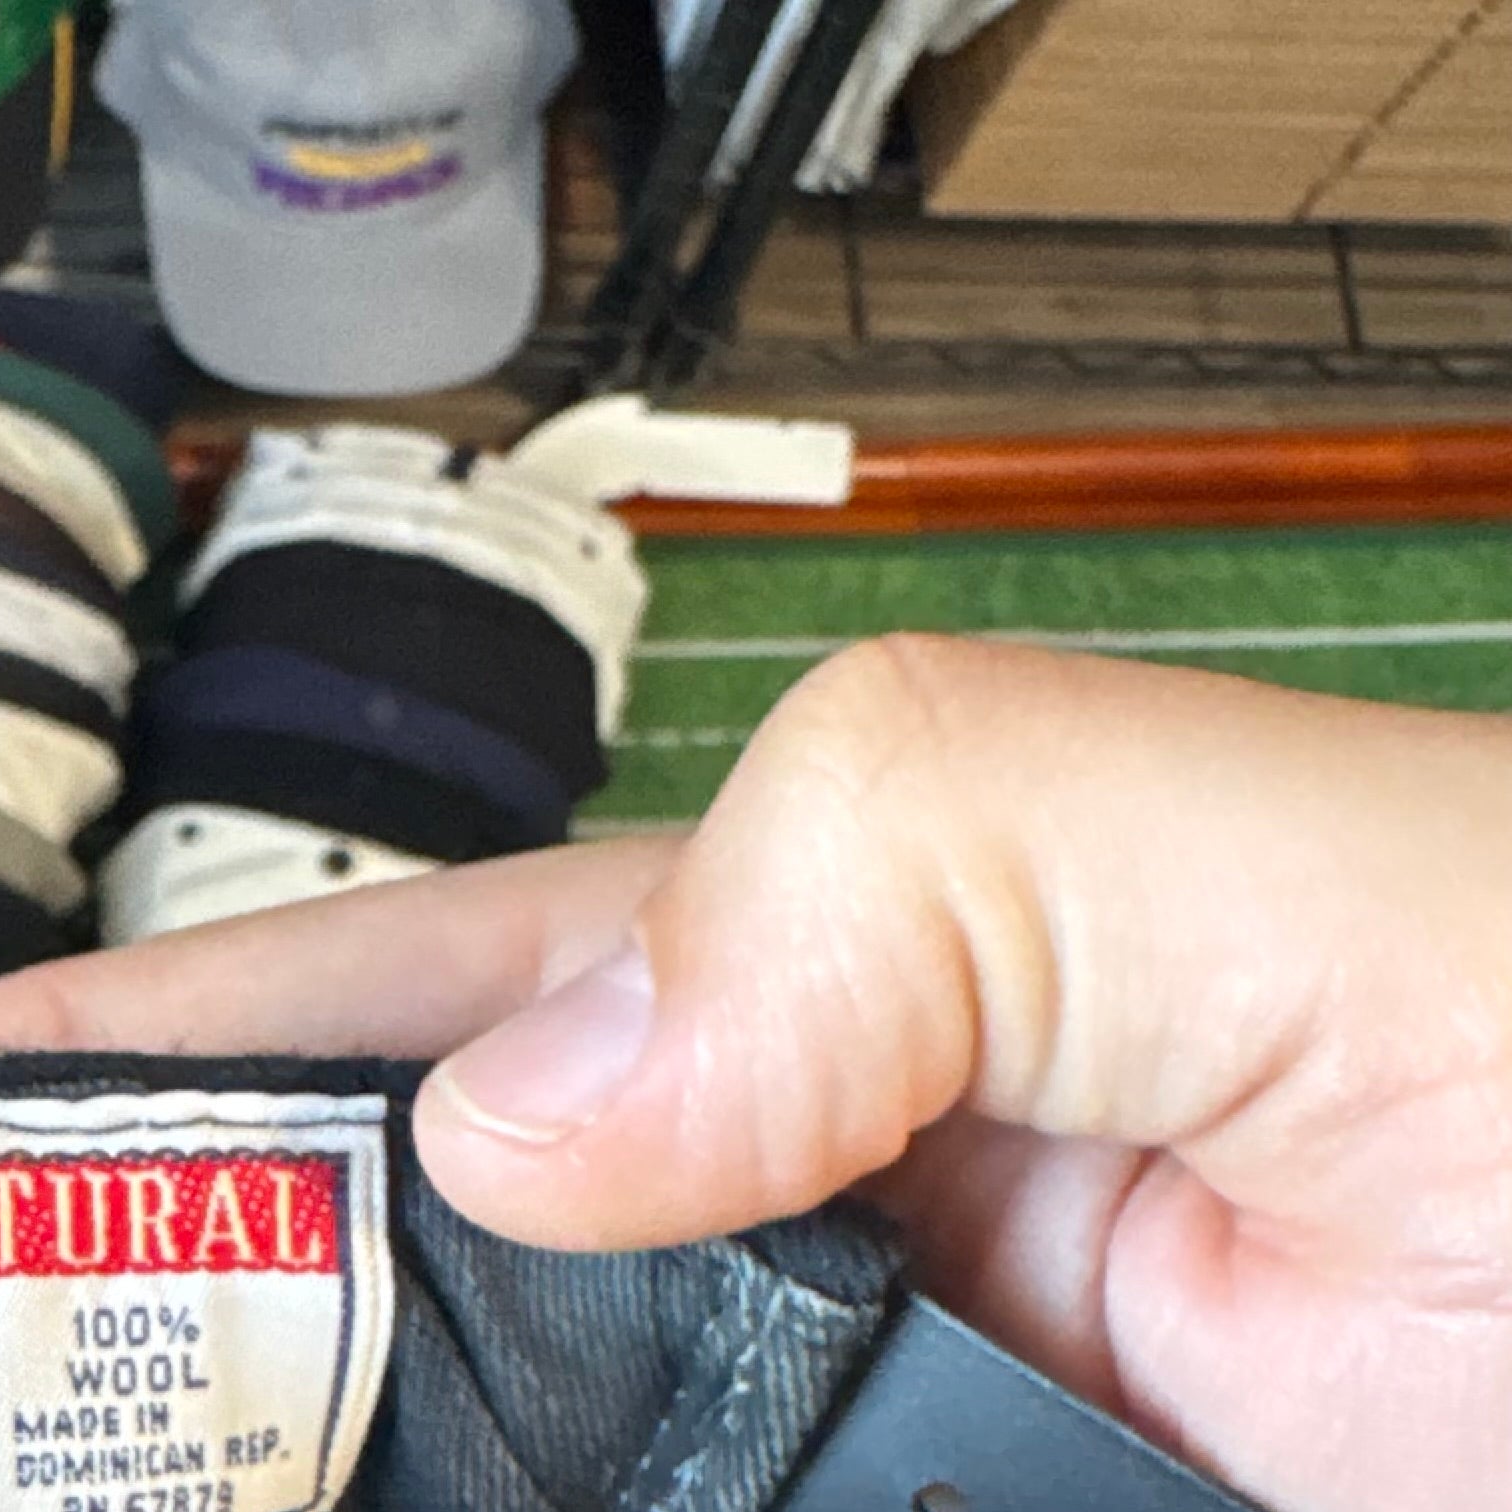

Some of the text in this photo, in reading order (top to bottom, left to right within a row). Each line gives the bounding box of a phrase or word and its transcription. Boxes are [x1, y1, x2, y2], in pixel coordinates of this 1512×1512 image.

[72, 1304, 201, 1350] 100%
[64, 1352, 211, 1397] WOOL
[11, 1401, 170, 1444] MADE IN
[15, 1424, 292, 1489] DOMINICAN REP.
